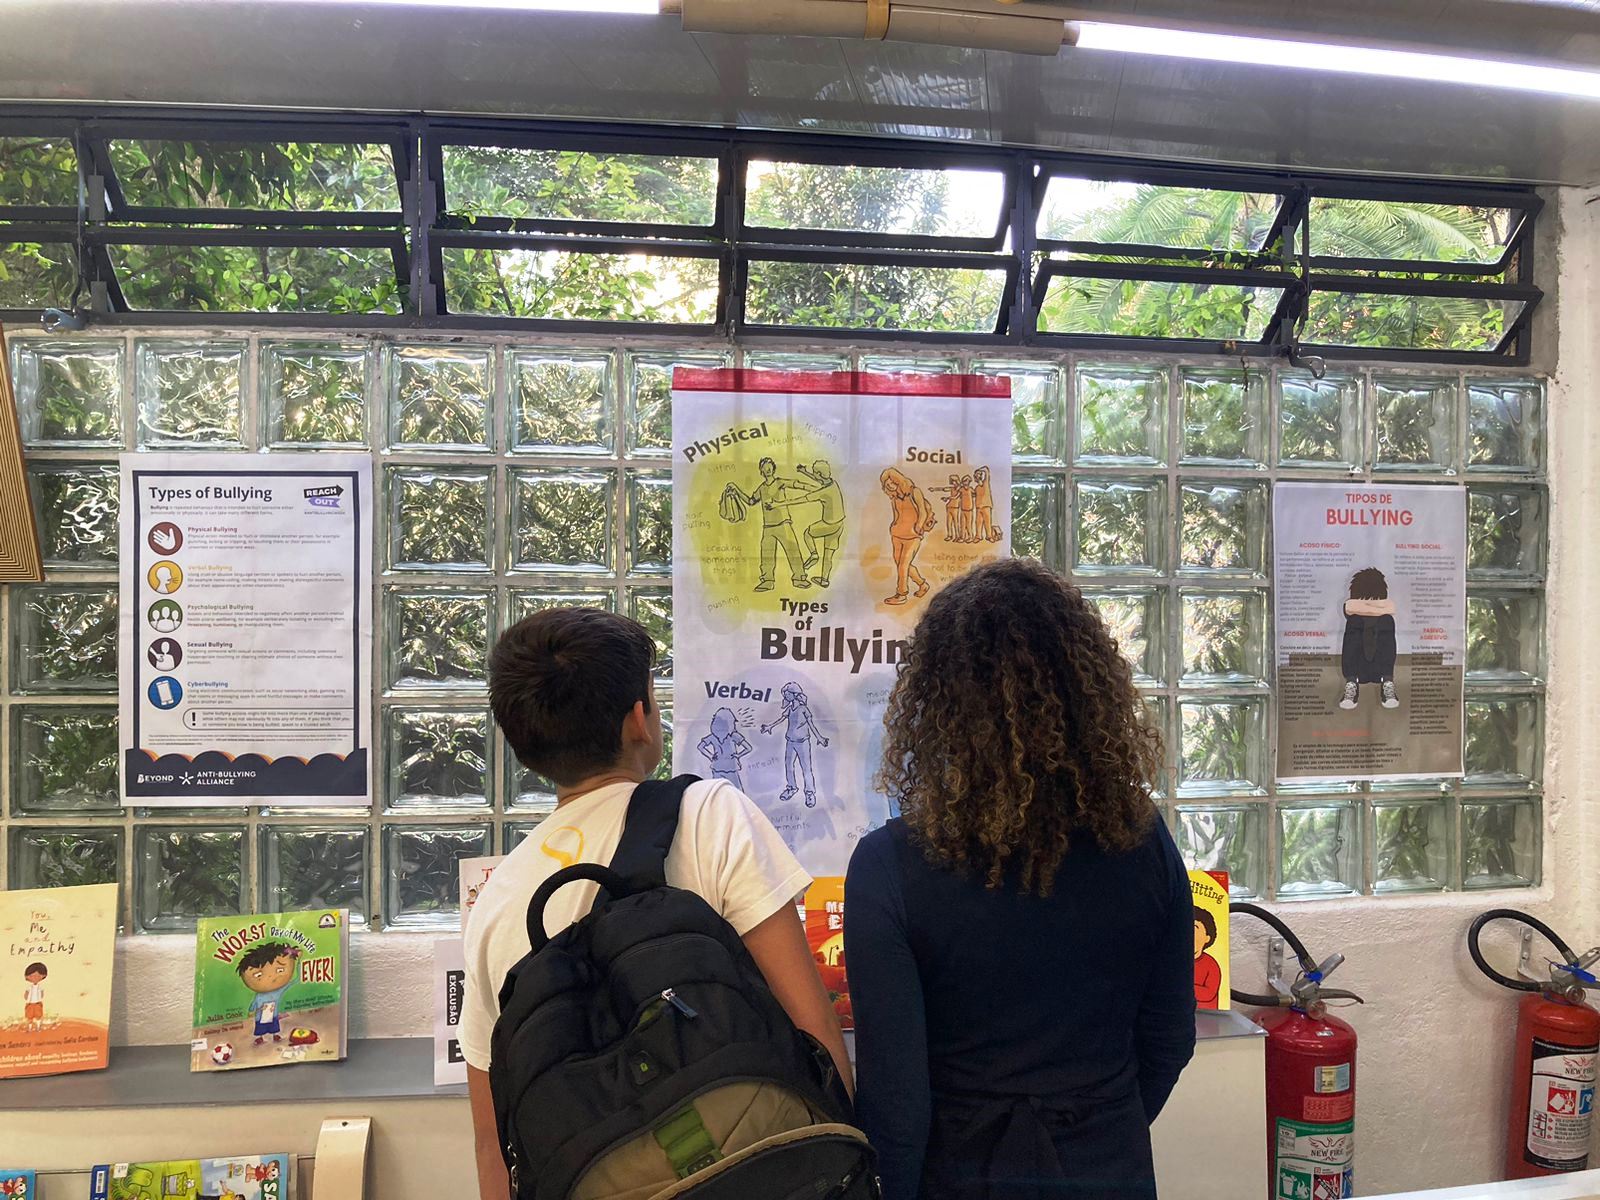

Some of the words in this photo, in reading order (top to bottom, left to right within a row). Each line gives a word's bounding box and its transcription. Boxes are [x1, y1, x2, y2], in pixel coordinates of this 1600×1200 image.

[682, 422, 769, 464] Physical
[906, 447, 962, 464] Social
[149, 487, 193, 502] Types
[195, 487, 211, 499] of
[214, 487, 273, 502] Bullying
[306, 487, 337, 497] REACH
[1345, 493, 1377, 504] TIPOS
[1379, 494, 1392, 504] DE
[314, 497, 335, 506] OUT
[1326, 508, 1414, 526] BULLYING
[780, 598, 829, 615] Types
[795, 616, 813, 630] of
[760, 626, 909, 674] Bullyin
[704, 681, 772, 702] Verbal
[137, 774, 174, 784] BEYOND
[30, 922, 47, 933] Me
[211, 928, 229, 942] The
[214, 922, 266, 963] WORST
[271, 926, 283, 938] Day
[293, 930, 305, 945] My
[304, 938, 316, 954] Life
[10, 941, 75, 957] Empathy
[302, 957, 334, 983] EVER!
[1565, 1067, 1581, 1075] NEW
[1311, 1149, 1328, 1157] NEW
